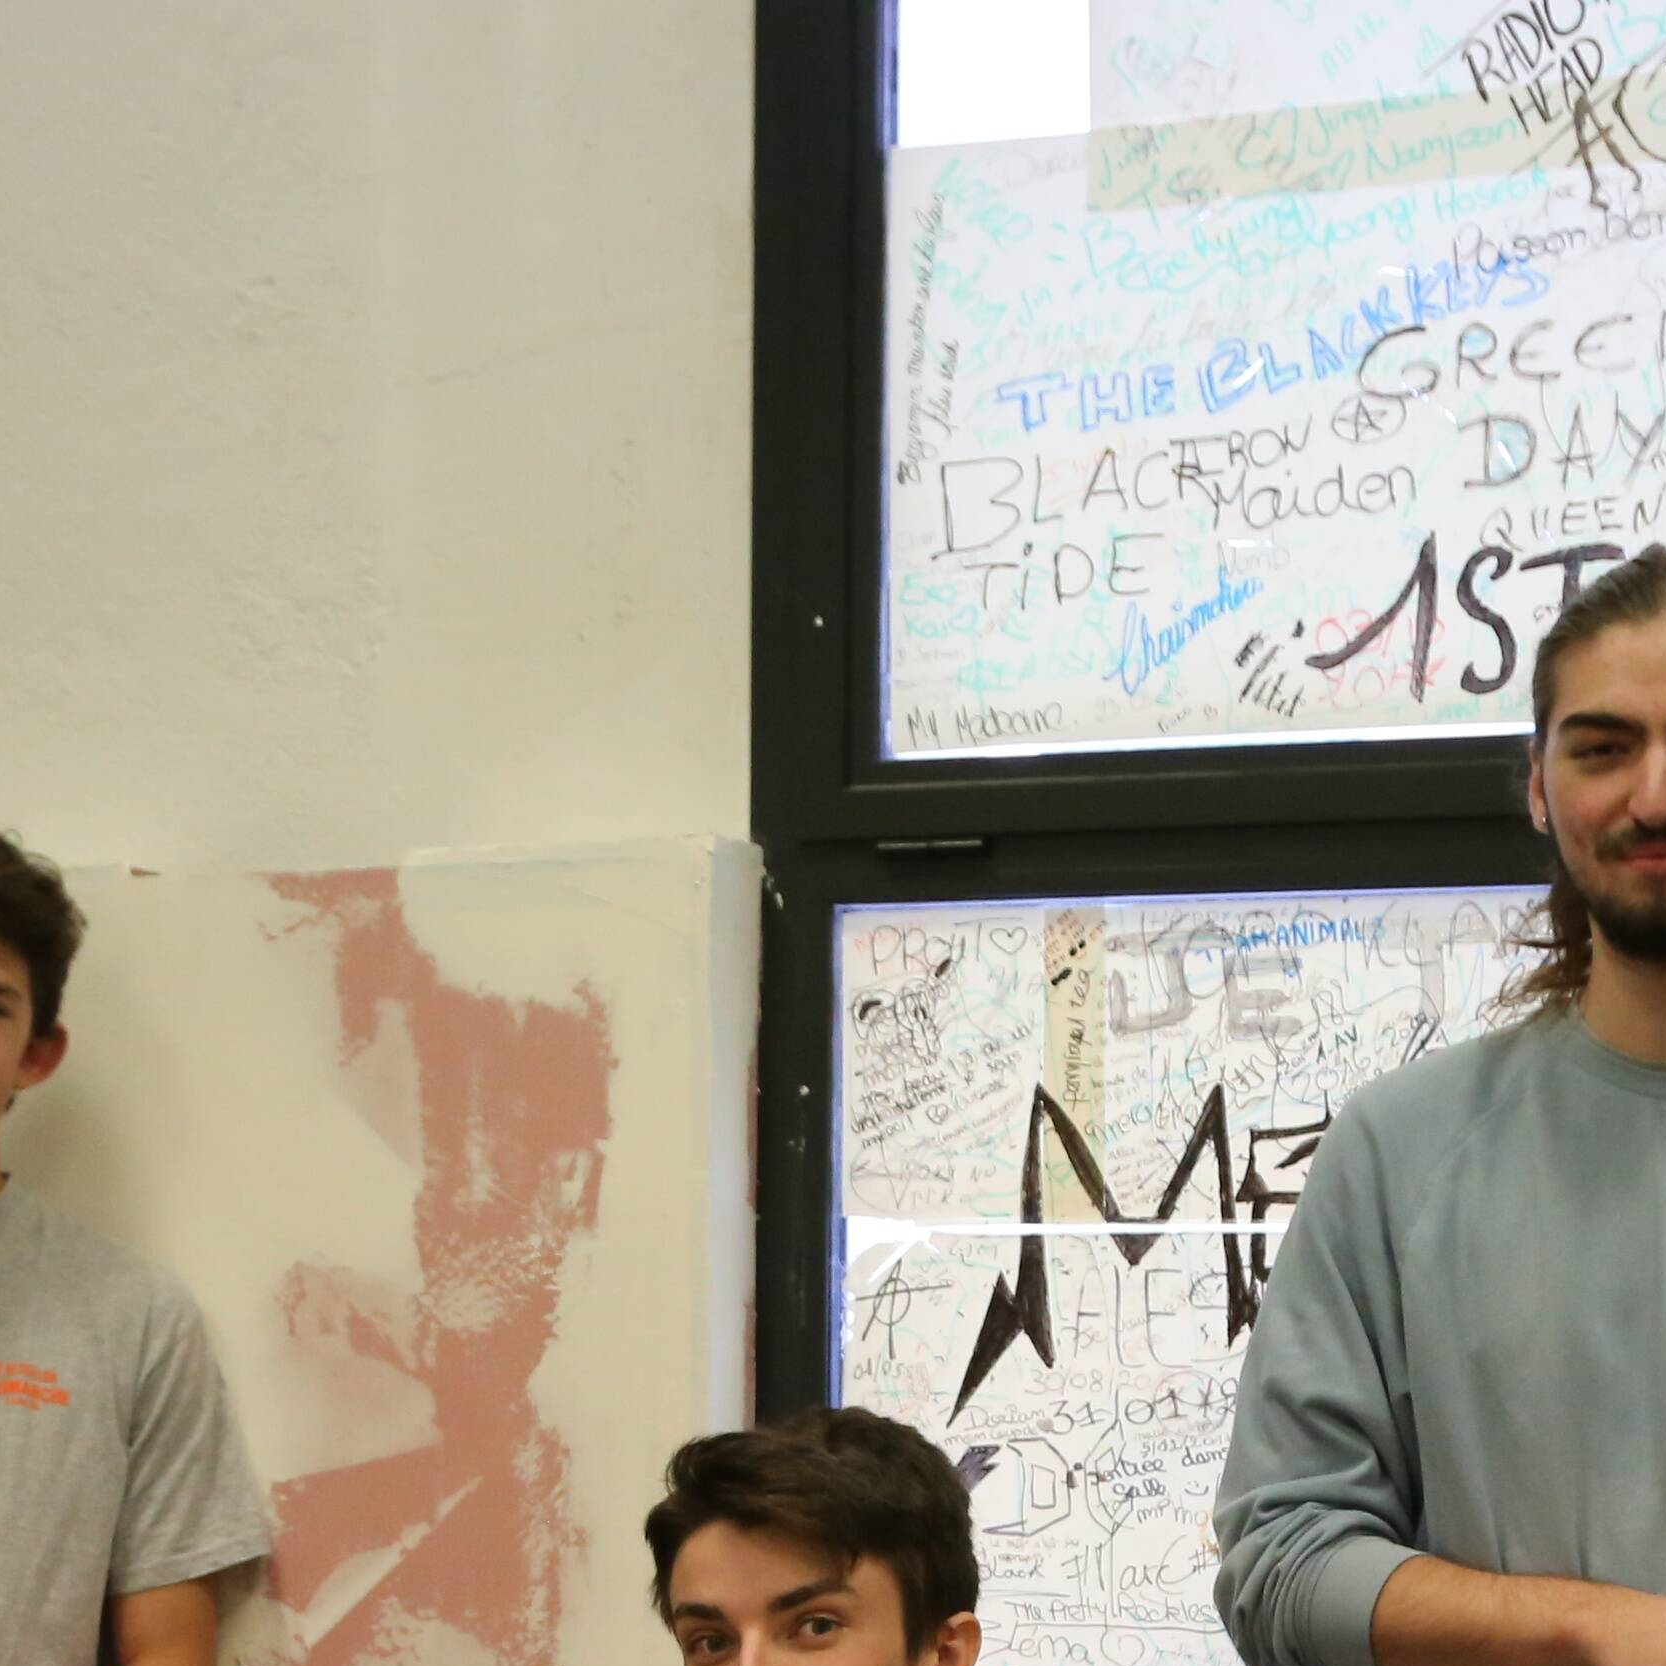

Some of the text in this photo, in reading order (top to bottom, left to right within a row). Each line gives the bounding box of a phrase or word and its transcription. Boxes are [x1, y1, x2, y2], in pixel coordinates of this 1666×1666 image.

[1462, 0, 1585, 103] RADIO
[1508, 37, 1604, 136] HEAD
[994, 363, 1176, 432] THE
[1457, 385, 1666, 493] DAY
[930, 446, 1213, 561] BLACK
[1211, 463, 1417, 531] Maiden
[1480, 482, 1666, 552] QUEEN
